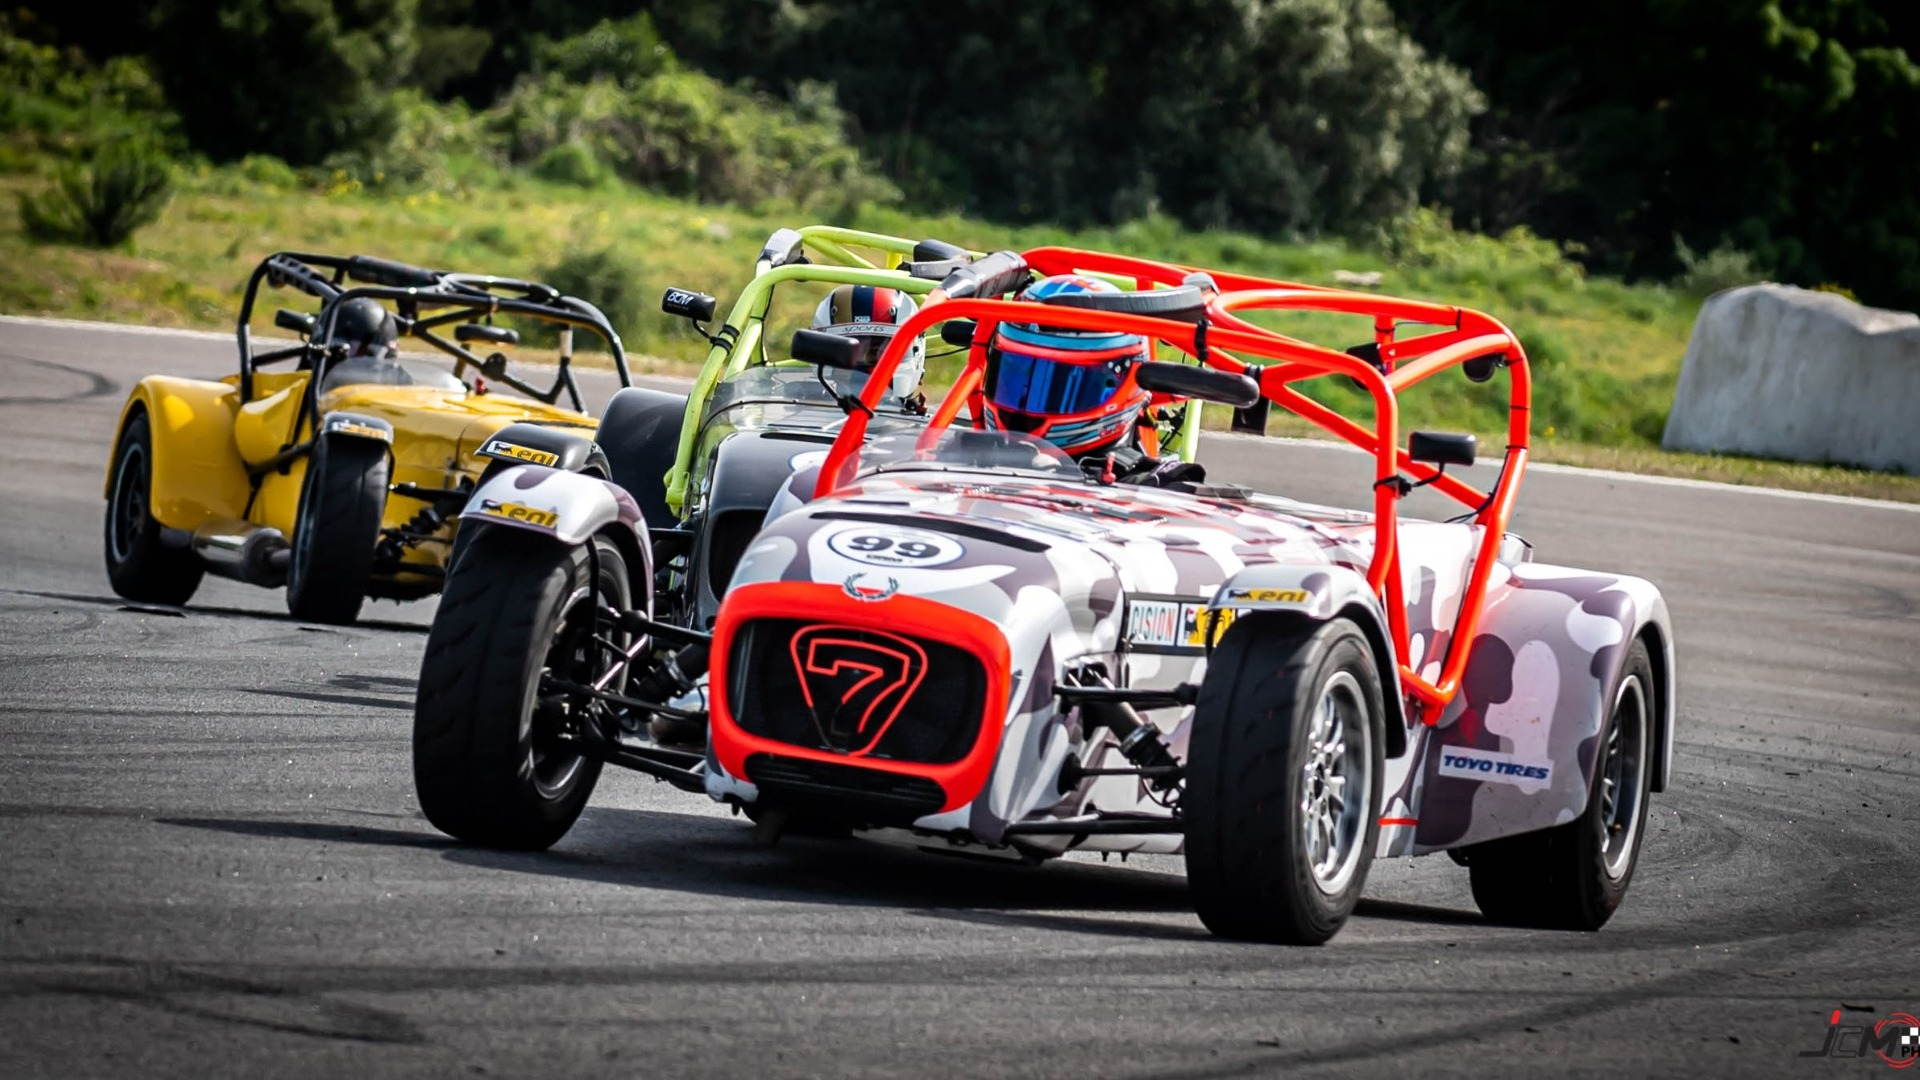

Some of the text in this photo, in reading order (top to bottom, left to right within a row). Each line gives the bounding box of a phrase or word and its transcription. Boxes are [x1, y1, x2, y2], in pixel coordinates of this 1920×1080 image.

[517, 449, 557, 466] eni
[508, 507, 558, 526] eni
[847, 536, 941, 559] 99
[1258, 590, 1308, 604] eni
[806, 638, 910, 737] 7
[1444, 755, 1550, 780] TOYO TIRES
